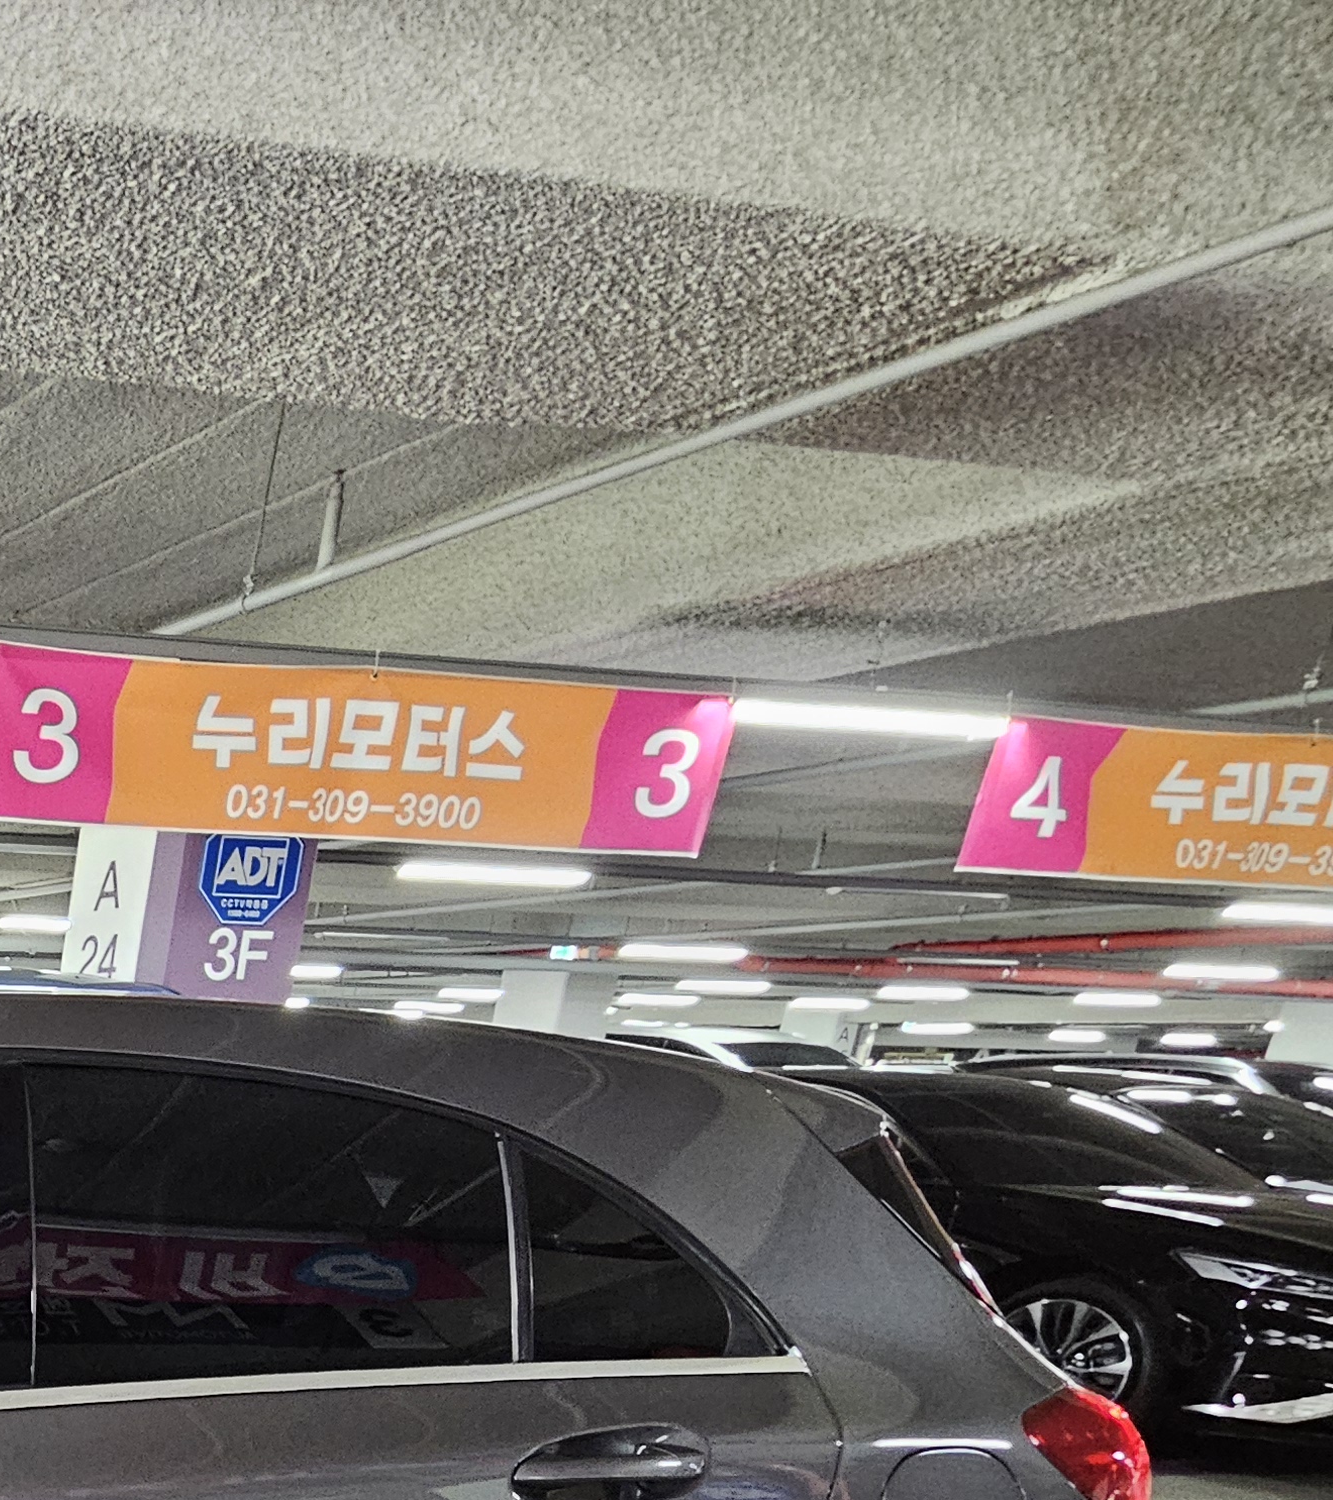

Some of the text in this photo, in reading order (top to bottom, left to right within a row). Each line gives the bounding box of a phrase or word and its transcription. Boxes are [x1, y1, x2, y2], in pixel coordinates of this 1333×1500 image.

[12, 687, 80, 784] 3
[191, 694, 525, 782] 누리모터스
[634, 727, 702, 820] 3
[1009, 756, 1068, 839] 4
[1150, 760, 1333, 828] 누리모
[225, 782, 482, 831] 031-309-3900
[93, 860, 120, 912] A
[215, 845, 288, 888] ADT
[80, 932, 120, 979] 24
[203, 926, 275, 982] 3F
[837, 1026, 850, 1043] A
